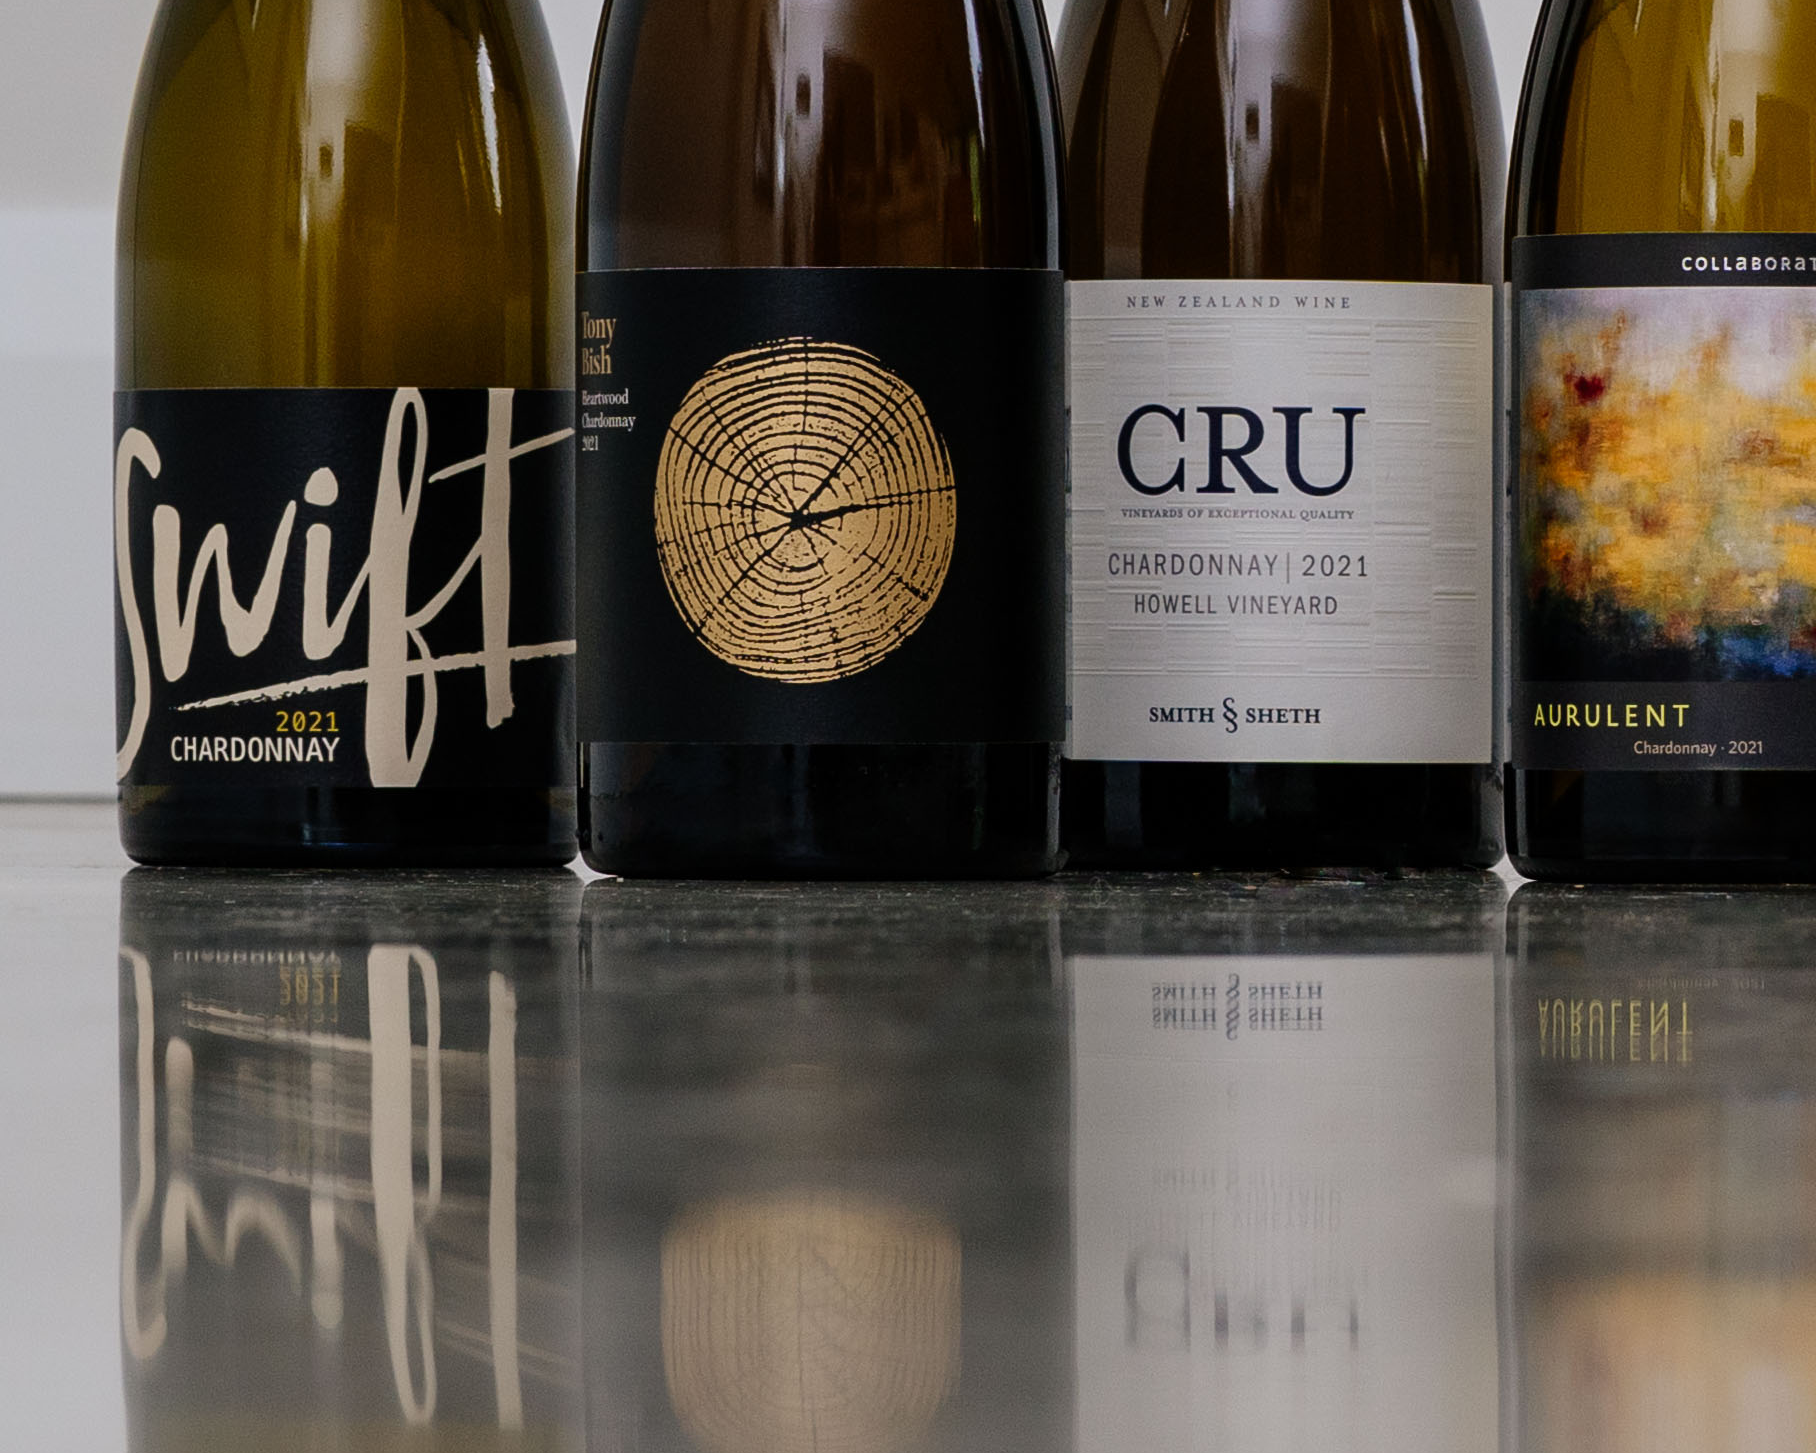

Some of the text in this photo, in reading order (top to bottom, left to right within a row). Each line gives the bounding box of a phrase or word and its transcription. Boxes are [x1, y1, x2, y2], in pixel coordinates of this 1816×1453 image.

[1126, 295, 1352, 309] NEW ZEALAND WINE
[581, 311, 617, 347] Tony
[581, 345, 612, 375] Bish
[582, 412, 636, 432] Chardonnay
[1116, 403, 1366, 497] CRU
[1121, 508, 1355, 521] VINEYARDS OF EXCEPTIONAL QUALITY
[1108, 552, 1369, 577] CHARDONNAY 2021
[114, 388, 576, 787] Swift
[1134, 594, 1339, 615] HOWELL VINEYARD
[275, 711, 340, 733] 2021
[1149, 706, 1214, 723] SMITH
[1245, 707, 1321, 724] SHETH
[1534, 703, 1690, 727] AURULENT
[170, 737, 340, 763] CHARDONNAY
[1633, 740, 1763, 756] Chardonnay 2021
